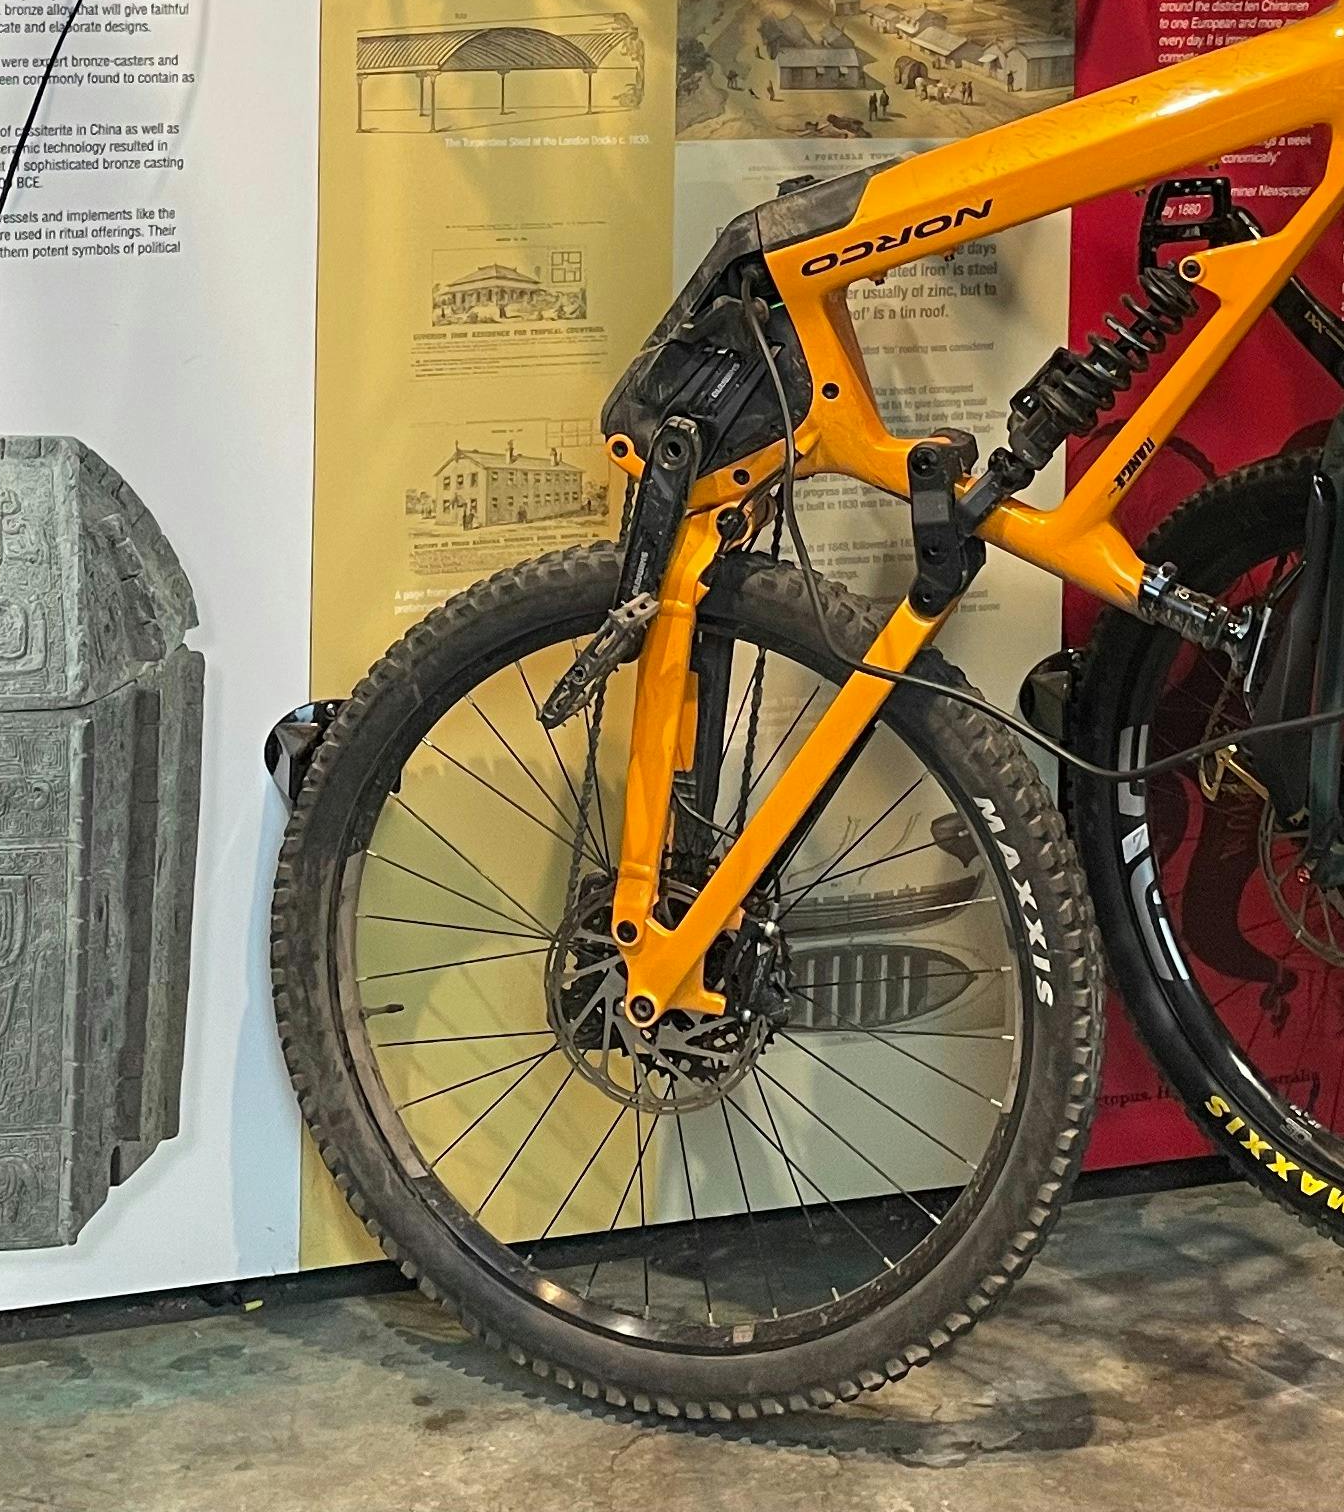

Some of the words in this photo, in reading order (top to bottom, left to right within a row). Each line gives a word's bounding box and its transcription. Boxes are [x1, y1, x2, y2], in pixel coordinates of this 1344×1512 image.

[801, 198, 994, 277] NORCO
[967, 241, 997, 264] days
[920, 261, 951, 277] iron'
[953, 262, 965, 276] is
[967, 261, 997, 276] steel
[863, 284, 909, 304] usually
[911, 282, 925, 299] of
[927, 281, 957, 301] zinc,
[960, 281, 981, 297] but
[984, 282, 998, 297] to
[872, 305, 885, 321] is
[888, 307, 897, 321] a
[899, 304, 918, 321] tin
[920, 304, 949, 320] roof.
[1113, 437, 1157, 489] RANGE
[971, 796, 1055, 1008] MAXXIS
